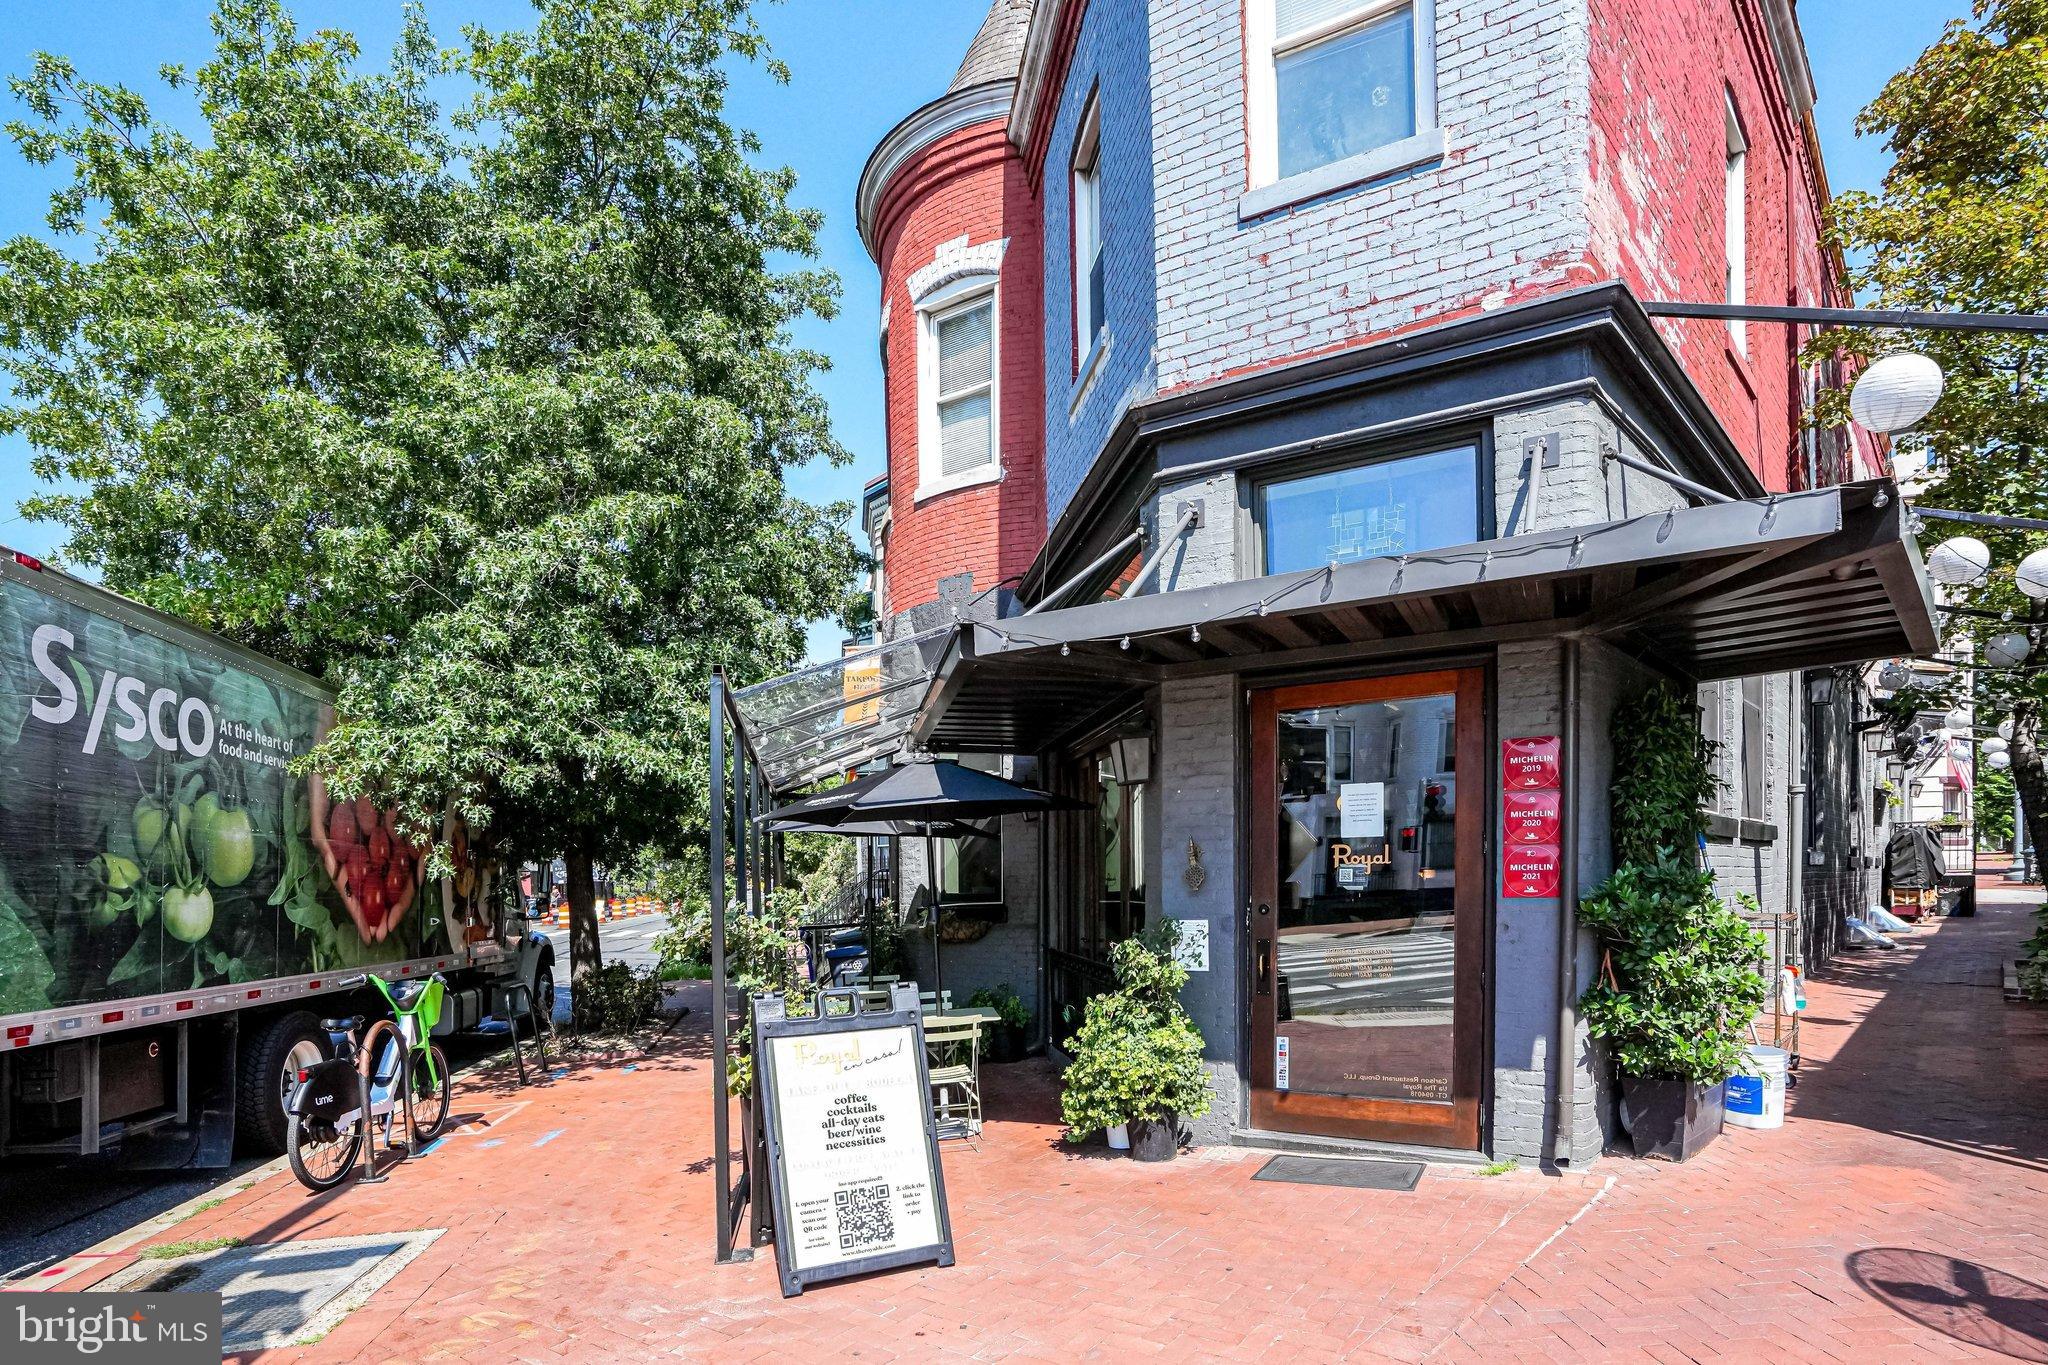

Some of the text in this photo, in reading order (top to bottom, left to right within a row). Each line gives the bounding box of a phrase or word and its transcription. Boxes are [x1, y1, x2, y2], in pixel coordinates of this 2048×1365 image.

[220, 718, 293, 753] At the heart of
[219, 738, 242, 758] food
[244, 749, 262, 763] and
[1510, 755, 1553, 764] MICHELIN
[1510, 810, 1554, 818] MICHELIN
[1331, 844, 1391, 875] Royal
[1510, 863, 1553, 871] MICHELIN
[1522, 872, 1540, 880] 2021
[834, 1093, 868, 1105] coffee
[827, 1102, 877, 1117] cocktails
[821, 1114, 885, 1129] all-day eats
[827, 1125, 881, 1139] beer/wine
[825, 1135, 886, 1151] necessities
[813, 1223, 828, 1231] code
